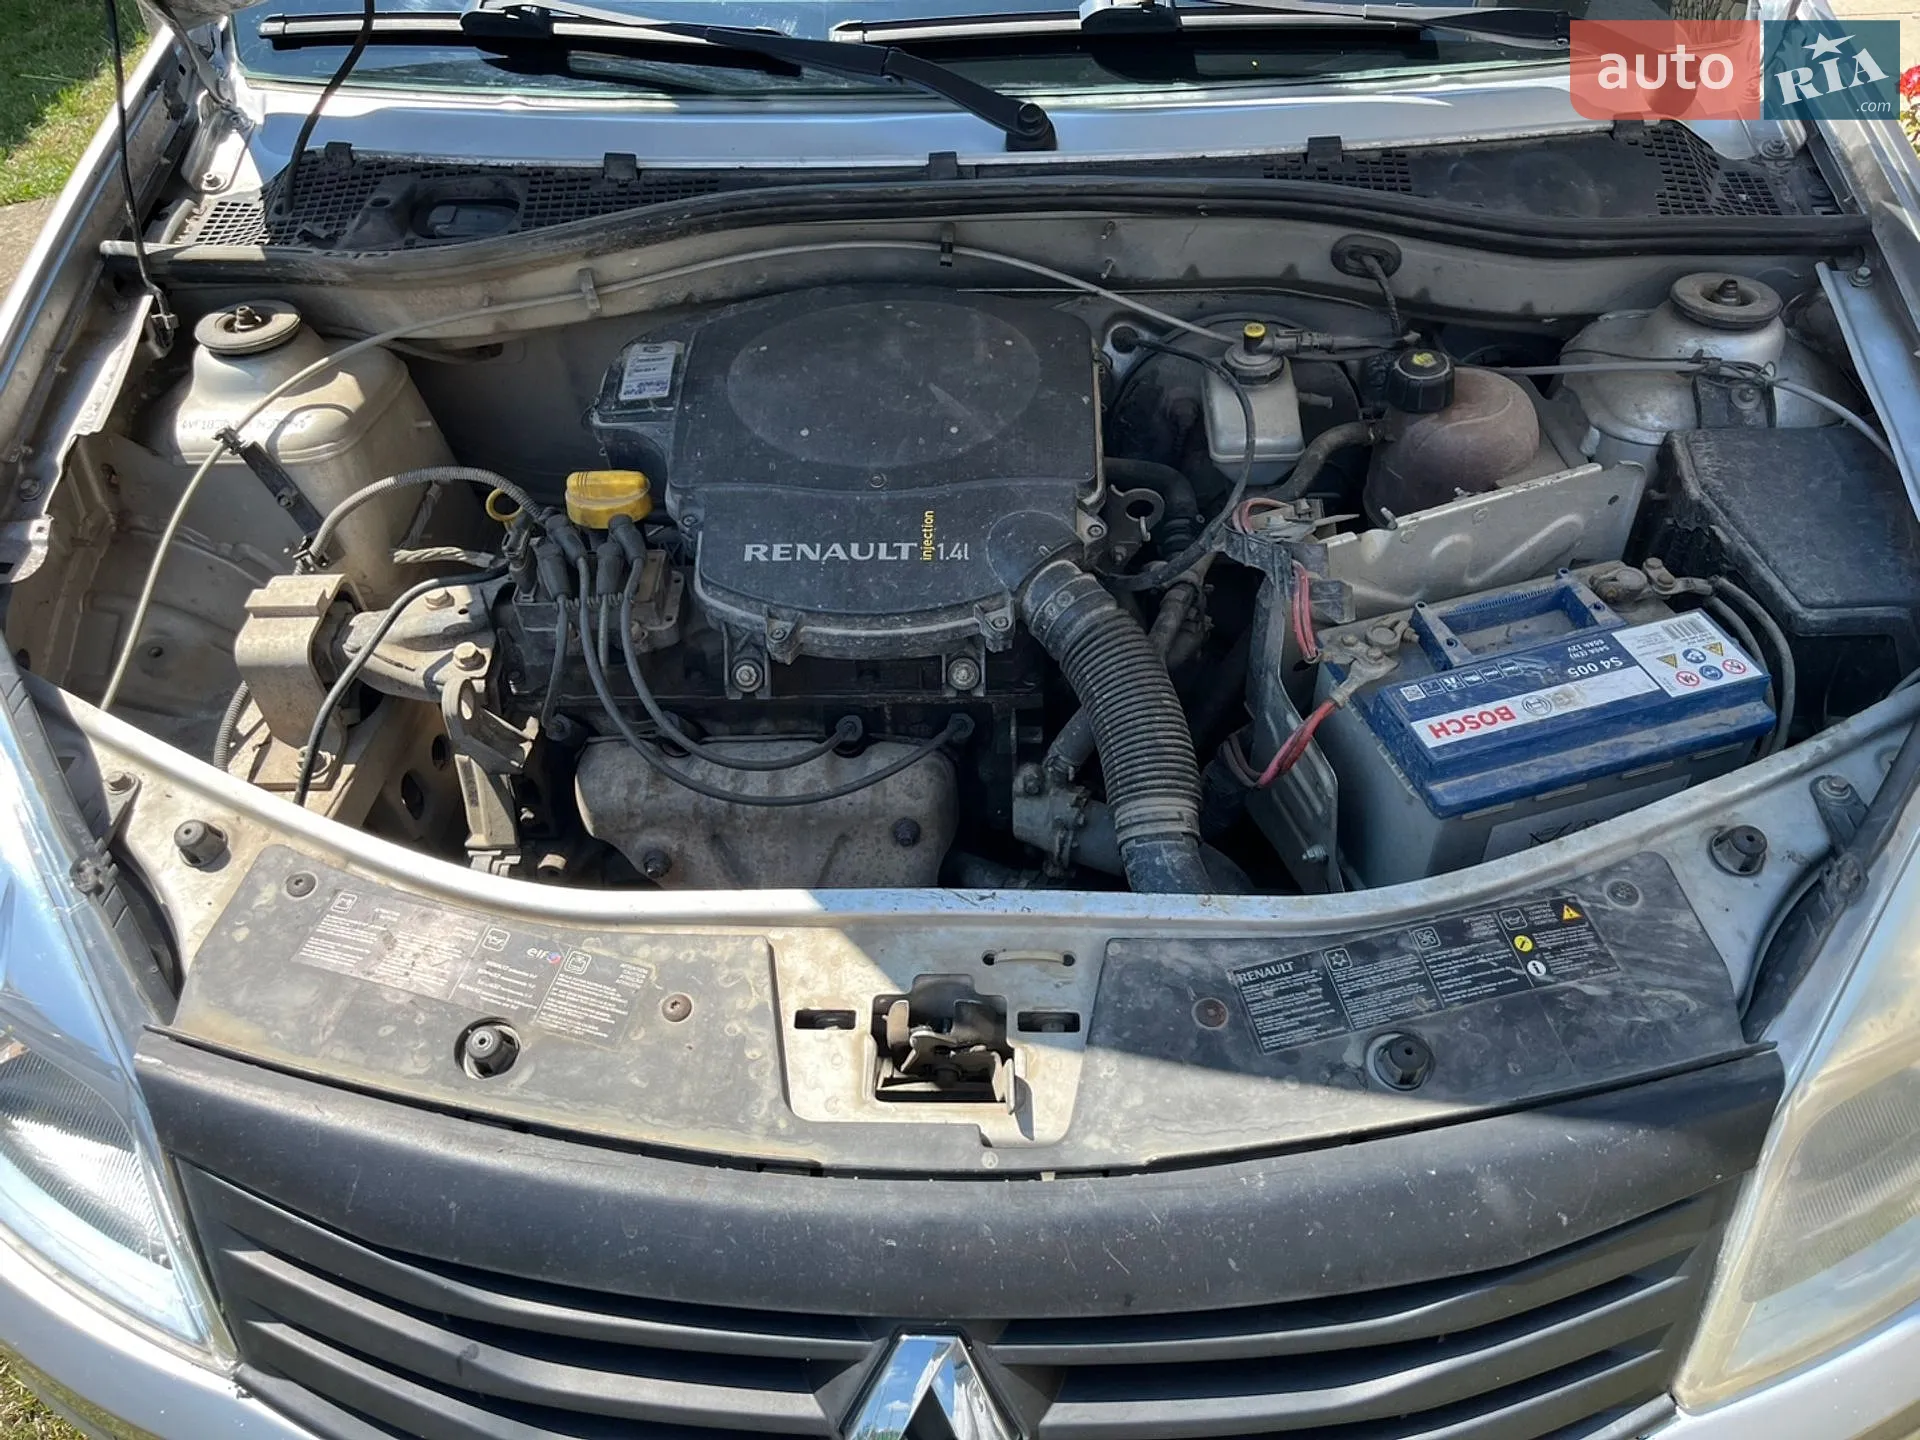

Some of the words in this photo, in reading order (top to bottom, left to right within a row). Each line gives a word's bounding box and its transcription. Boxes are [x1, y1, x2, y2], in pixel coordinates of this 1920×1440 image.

[920, 510, 935, 561] injection
[744, 543, 917, 562] RENAULT
[1567, 661, 1599, 677] 005
[1600, 655, 1623, 670] S4
[1427, 705, 1516, 740] BOSCH
[526, 946, 549, 960] elf
[1238, 961, 1294, 983] RENAULT
